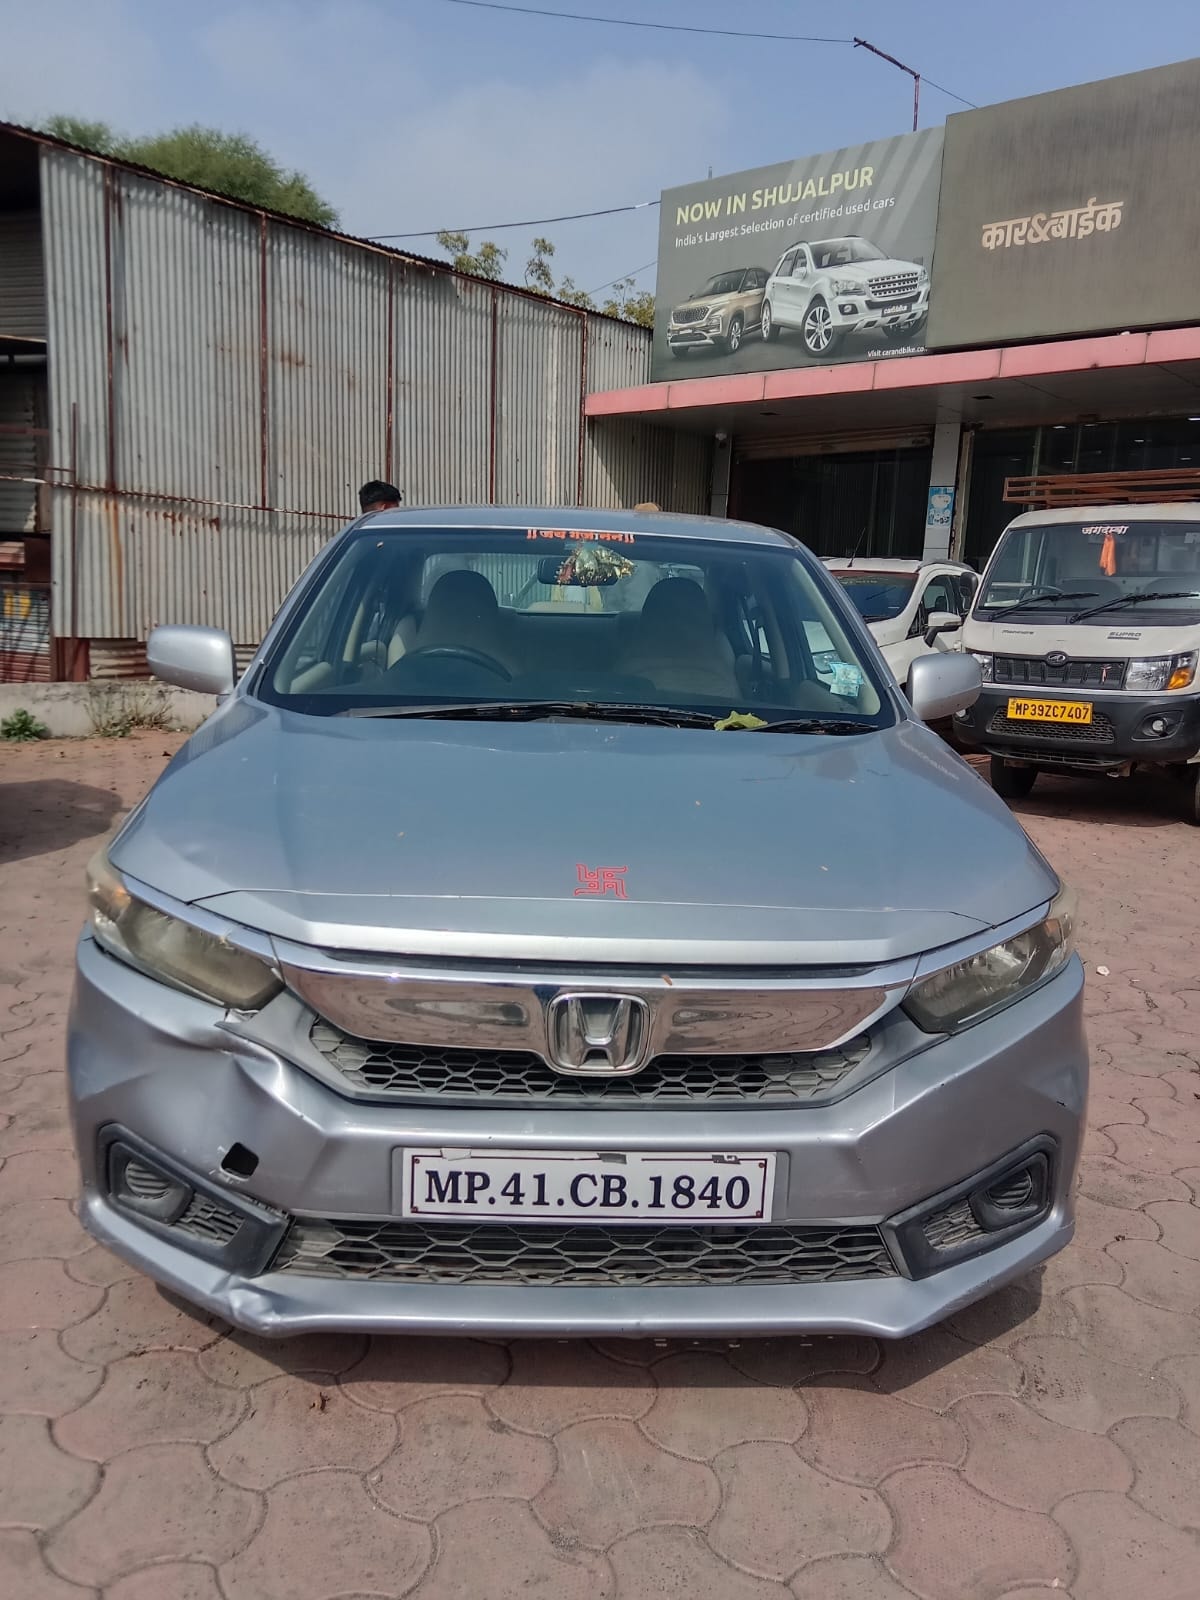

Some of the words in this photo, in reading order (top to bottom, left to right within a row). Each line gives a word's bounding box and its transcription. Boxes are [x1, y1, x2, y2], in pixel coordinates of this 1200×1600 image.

[676, 198, 723, 226] NOW
[726, 193, 747, 215] IN
[751, 166, 874, 210] SHUJALPUR
[675, 233, 703, 248] India's
[705, 226, 739, 242] Largest
[741, 218, 785, 235] Selection
[786, 213, 799, 226] of
[799, 206, 843, 224] certified
[845, 200, 870, 215] used
[872, 197, 895, 210] cars
[981, 197, 1124, 250] कार&बाईक
[867, 350, 881, 358] Visit
[1015, 703, 1090, 720] MP39ZC7407
[424, 1169, 751, 1210] MP.41.CB.1840
